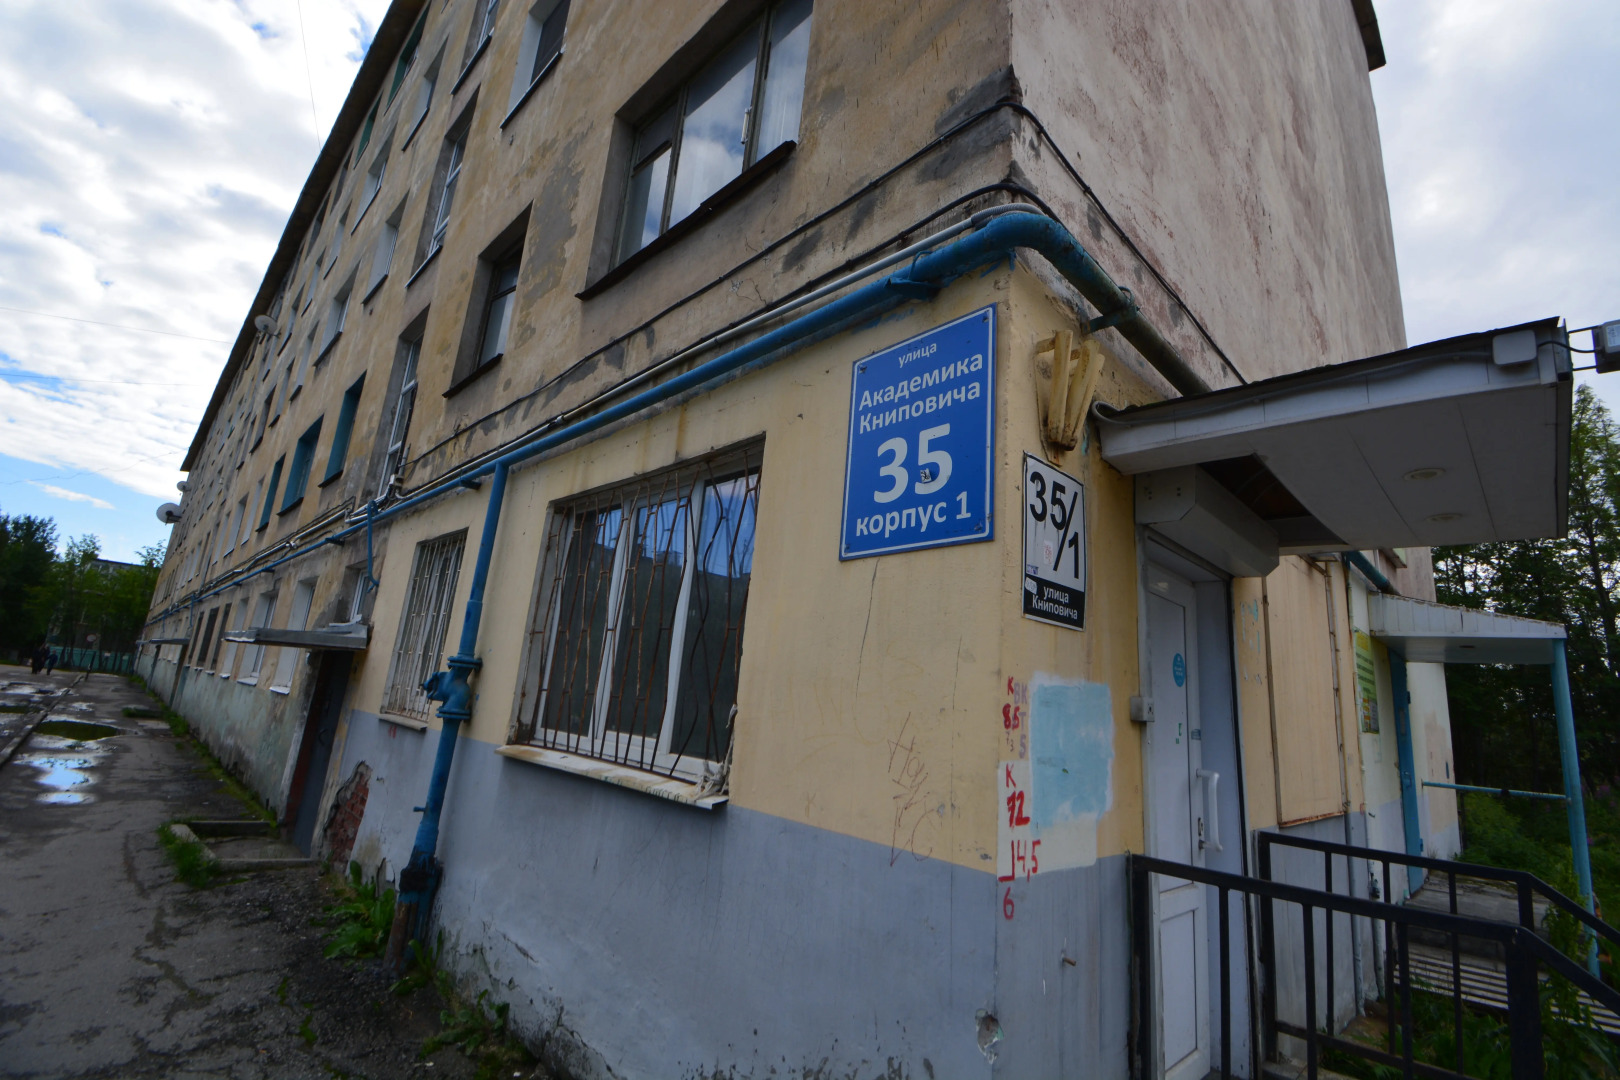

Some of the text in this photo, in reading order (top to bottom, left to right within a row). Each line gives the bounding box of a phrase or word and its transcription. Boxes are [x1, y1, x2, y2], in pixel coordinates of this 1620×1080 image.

[898, 342, 938, 369] улица
[859, 353, 983, 411] Академика
[859, 381, 981, 434] Книповича
[873, 422, 953, 504] 35
[856, 490, 972, 538] корпус 1
[1029, 471, 1080, 580] 35/1
[1032, 594, 1078, 620] Книповича
[1043, 586, 1069, 604] улица
[1003, 886, 1015, 921] 6
